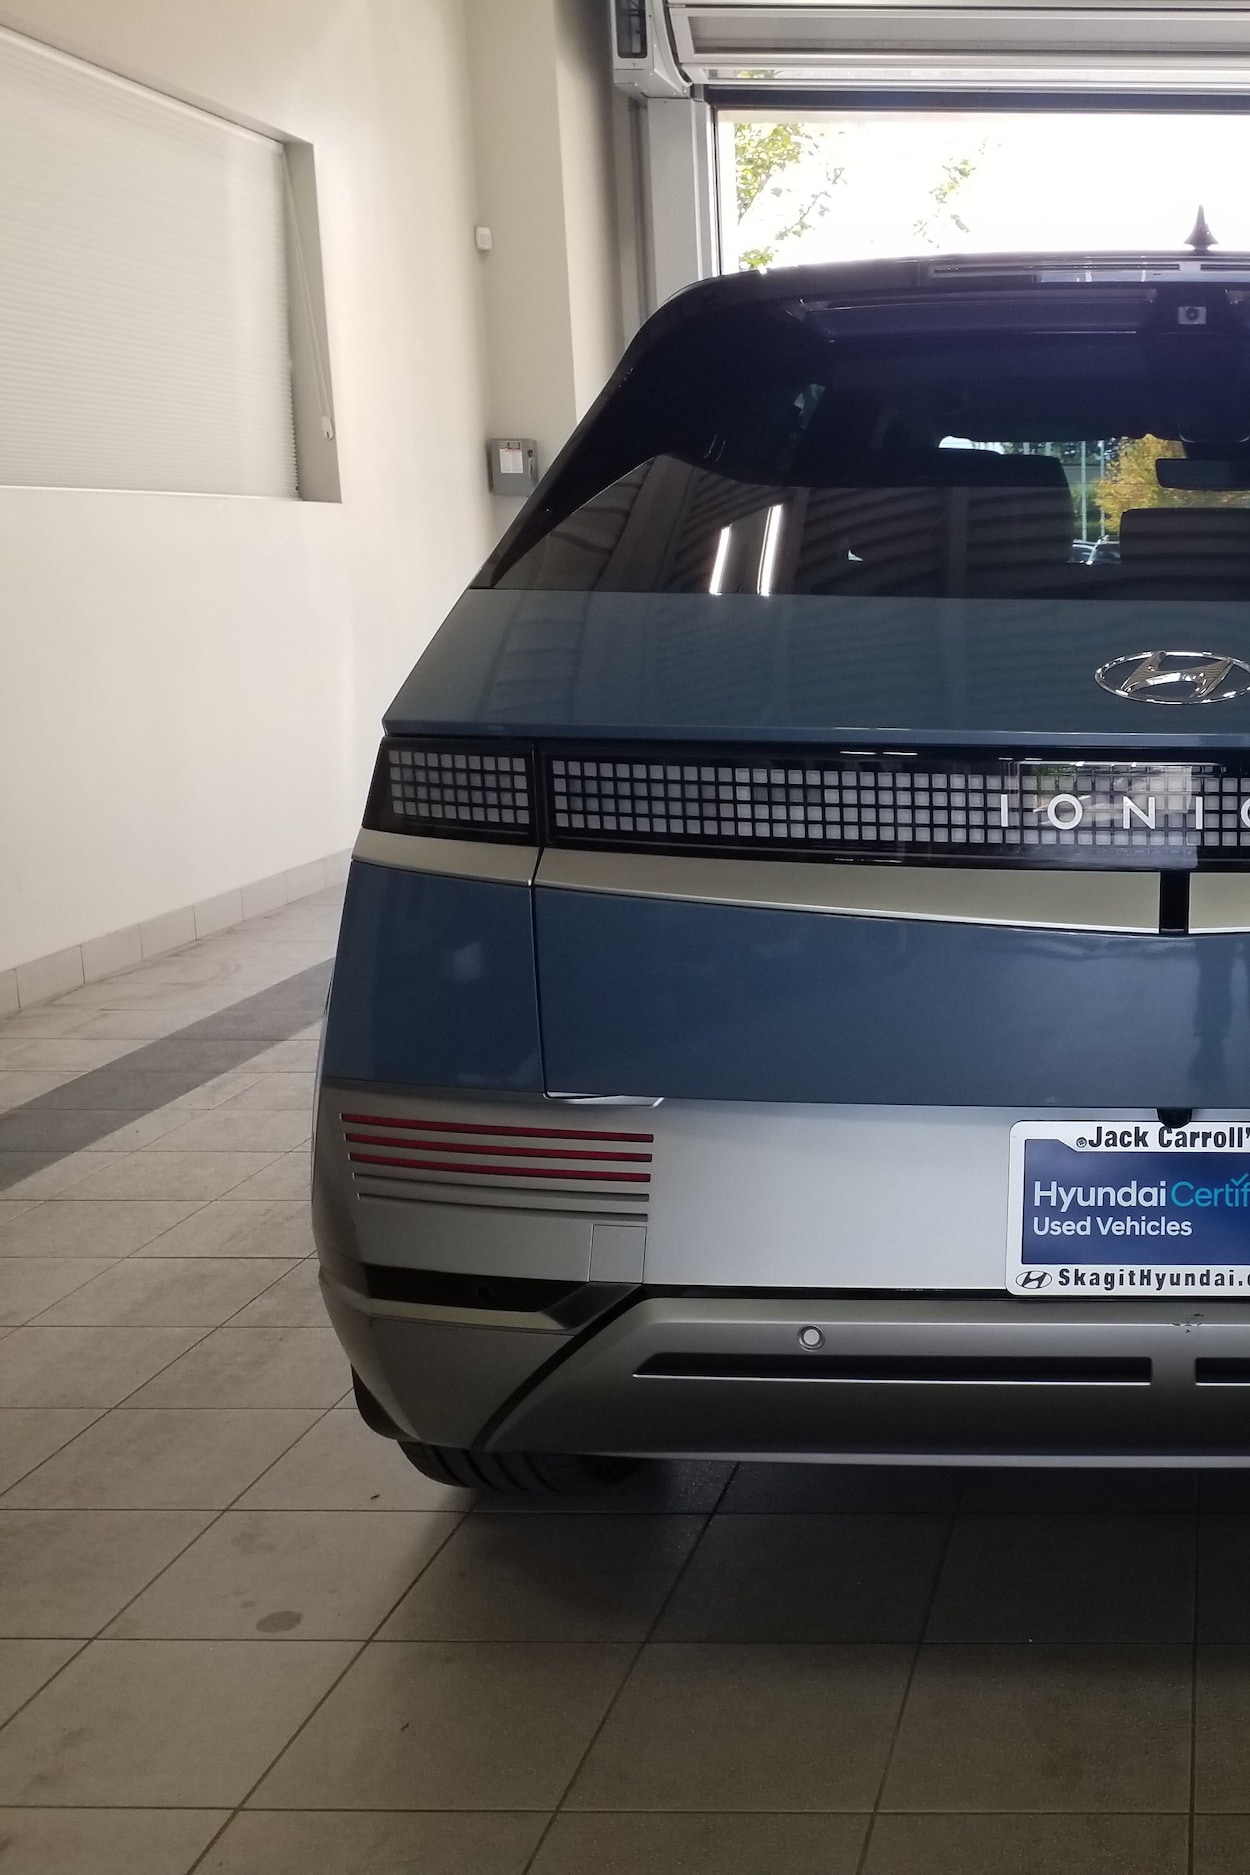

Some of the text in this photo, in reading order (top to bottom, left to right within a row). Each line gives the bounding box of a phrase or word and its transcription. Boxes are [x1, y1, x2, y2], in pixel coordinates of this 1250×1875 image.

[1089, 1126, 1149, 1148] Jack
[1033, 1181, 1167, 1212] Hyundai
[1033, 1217, 1192, 1236] Used Vehicles
